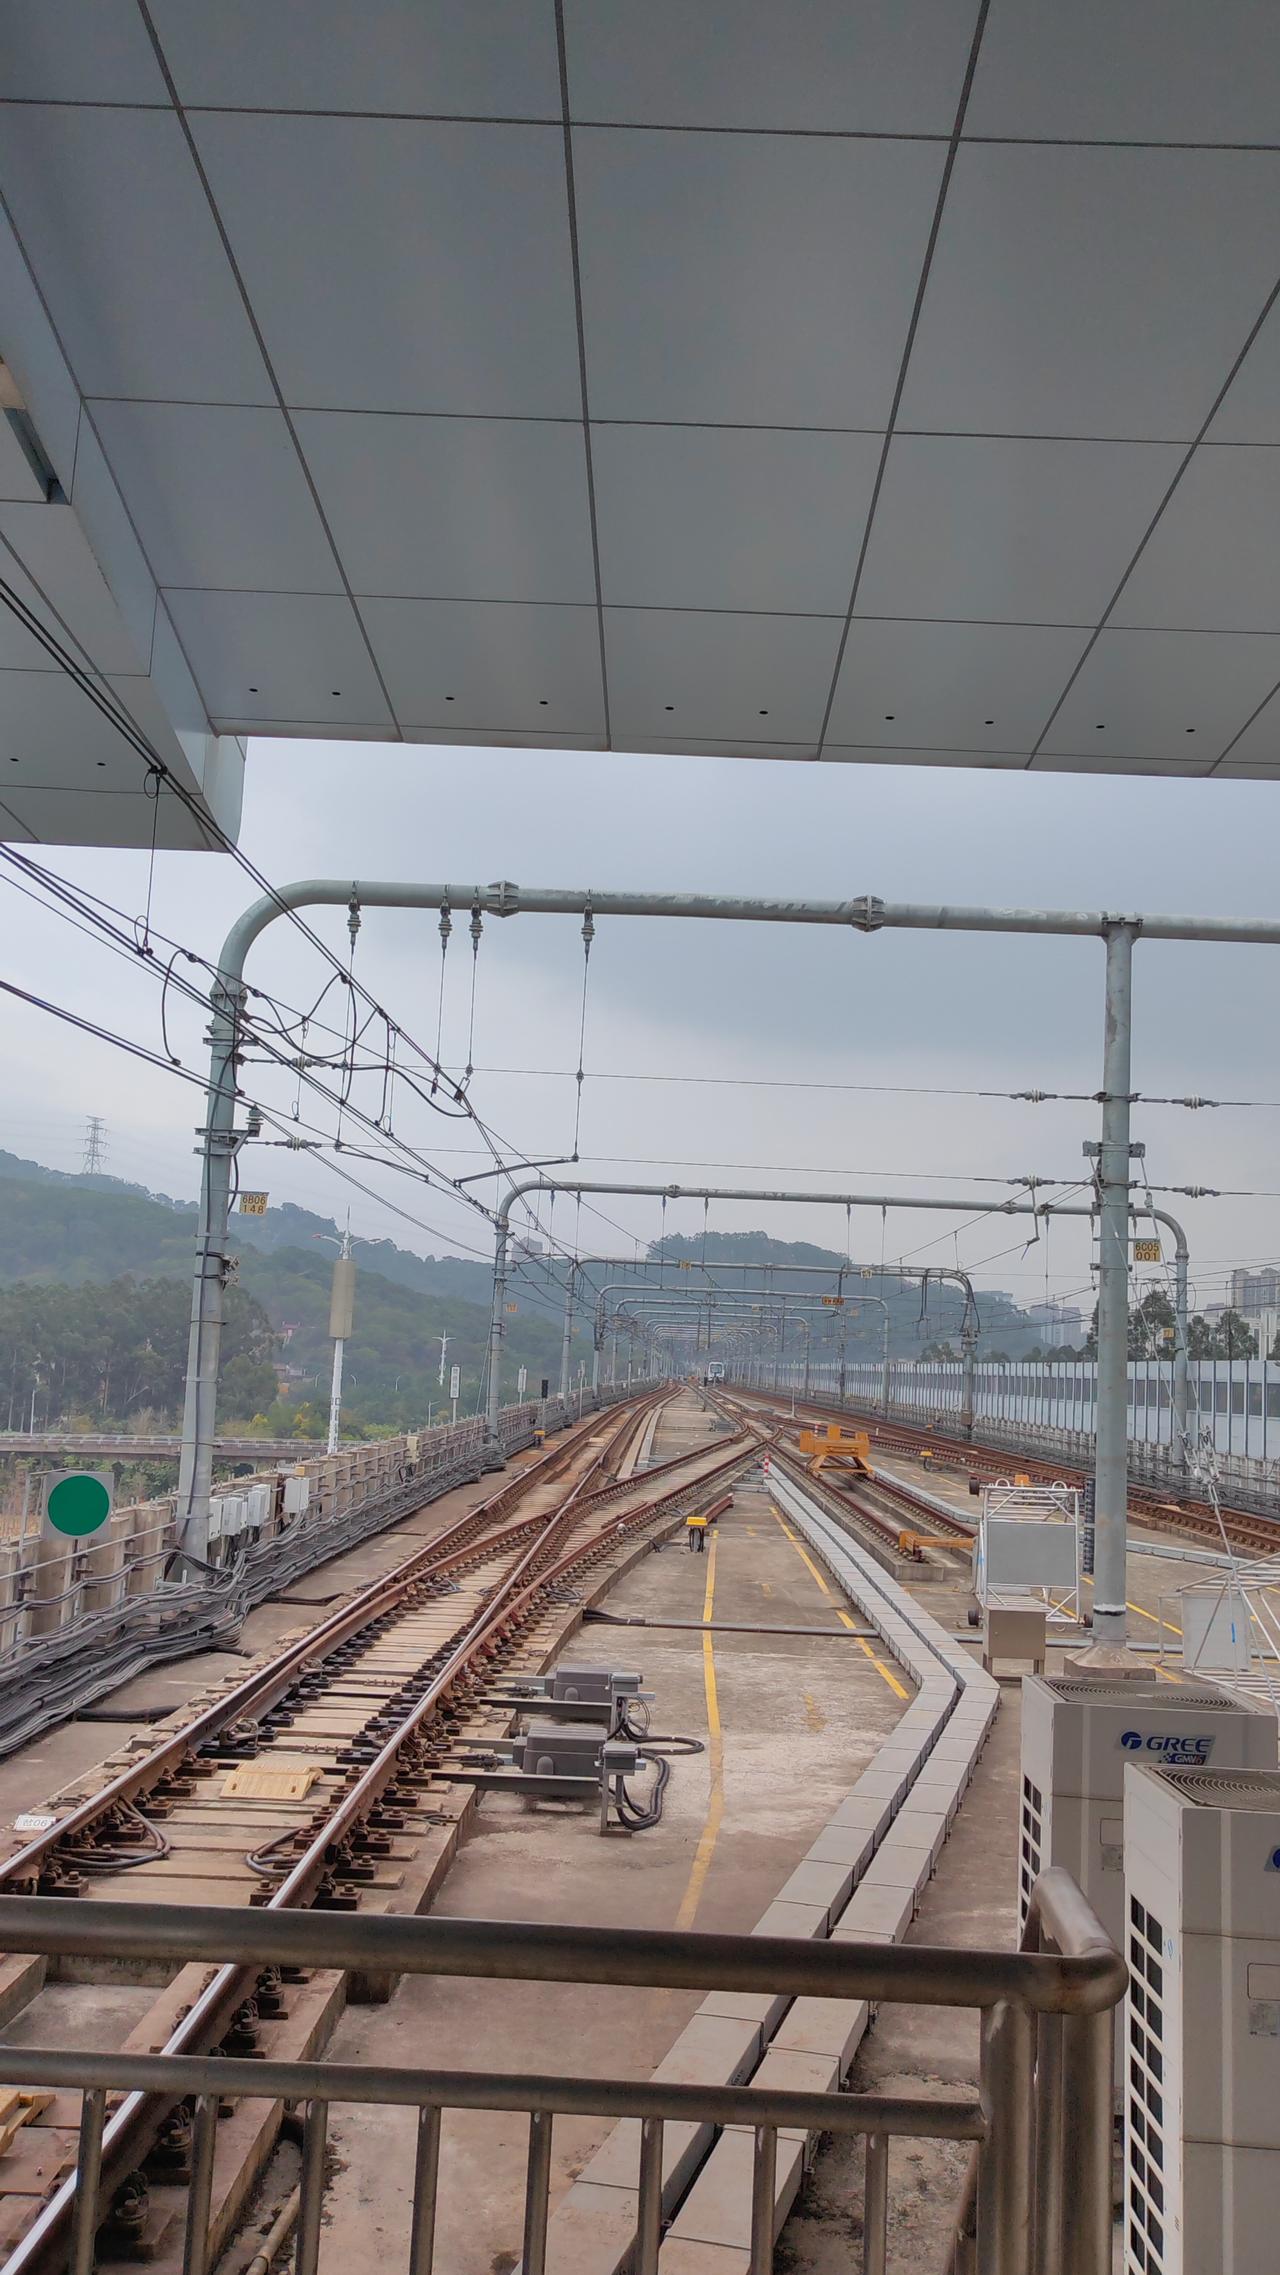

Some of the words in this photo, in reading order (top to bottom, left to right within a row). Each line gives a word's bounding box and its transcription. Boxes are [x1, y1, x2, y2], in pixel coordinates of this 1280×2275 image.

[243, 1205, 264, 1214] 148
[1135, 1242, 1159, 1251] 6C05
[1136, 1252, 1157, 1261] 001
[1146, 1736, 1211, 1753] GREE
